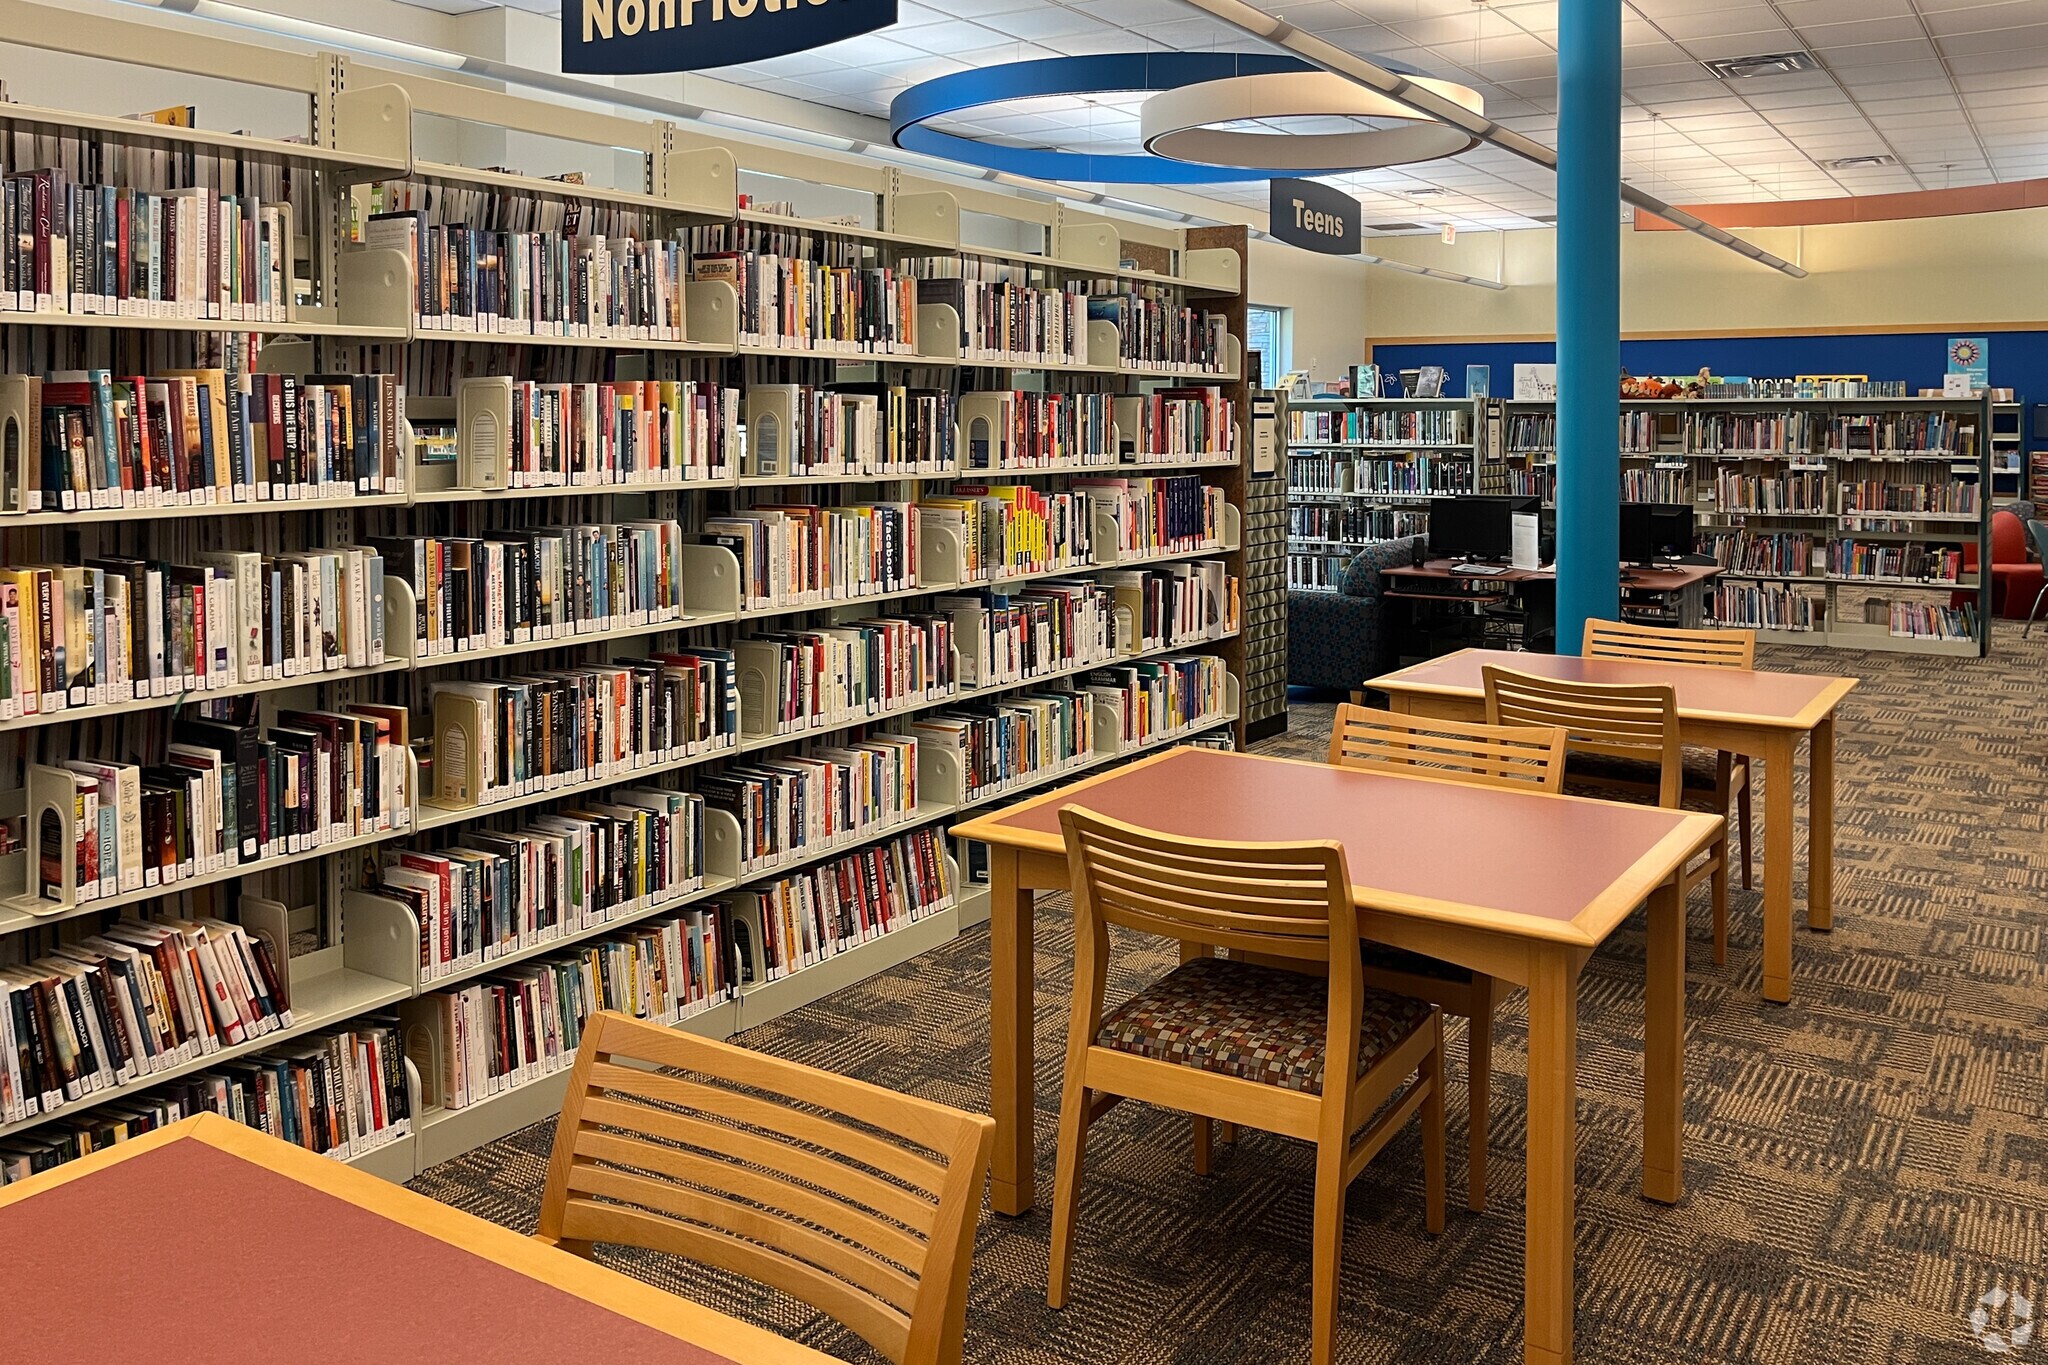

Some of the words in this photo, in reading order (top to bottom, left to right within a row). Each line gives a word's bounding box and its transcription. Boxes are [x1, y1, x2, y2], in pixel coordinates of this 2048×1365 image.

[1292, 198, 1344, 238] Teens
[76, 268, 84, 294] WALKE
[285, 379, 295, 387] IS
[385, 381, 395, 407] JESUS
[285, 390, 295, 408] THIS
[286, 411, 296, 425] THE
[386, 408, 395, 422] ON
[286, 428, 297, 449] END?
[387, 423, 396, 450] TRIAL
[41, 582, 50, 602] EVERY
[354, 561, 362, 603] AWAKEN
[42, 602, 51, 614] DAY
[551, 690, 559, 725] STANLEY
[926, 849, 936, 877] RETURN
[421, 894, 429, 926] fasting
[786, 886, 794, 929] OBSESSION
